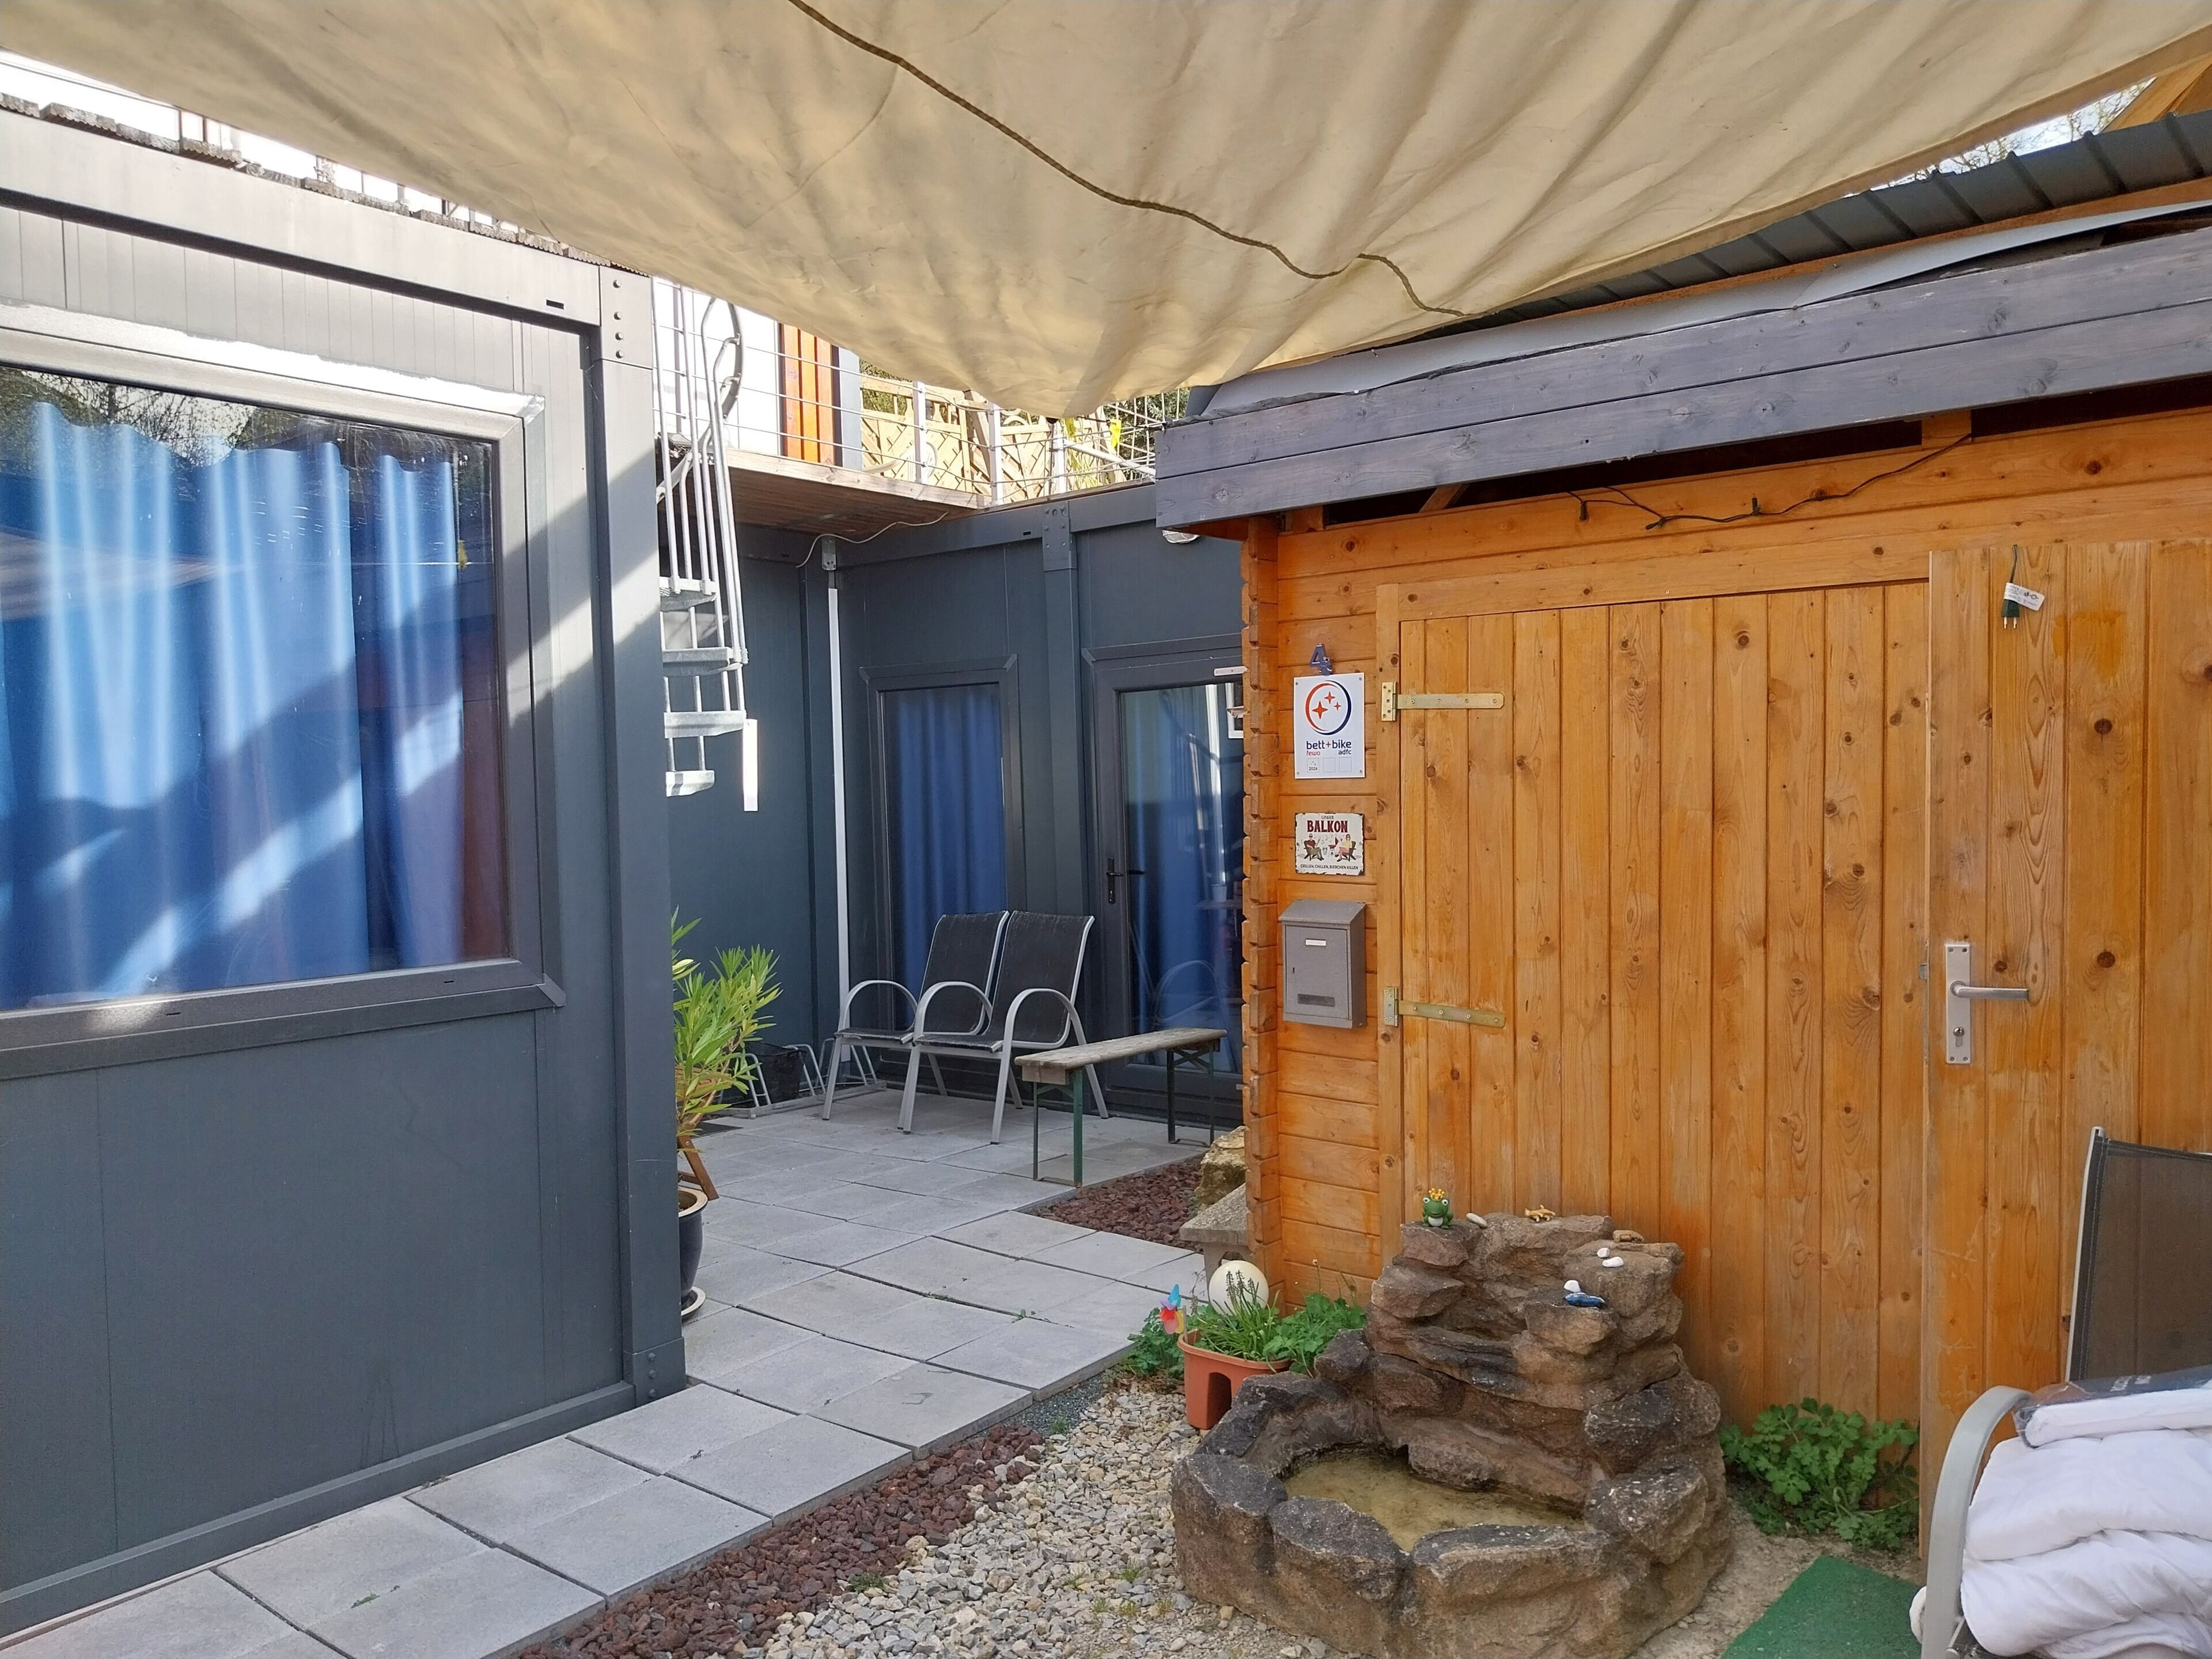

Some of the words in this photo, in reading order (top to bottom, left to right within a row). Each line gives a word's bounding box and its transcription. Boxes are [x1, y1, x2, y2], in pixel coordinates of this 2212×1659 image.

[1309, 643, 1331, 675] 4
[1306, 740, 1352, 749] bett+bike
[1306, 820, 1349, 833] BALKON
